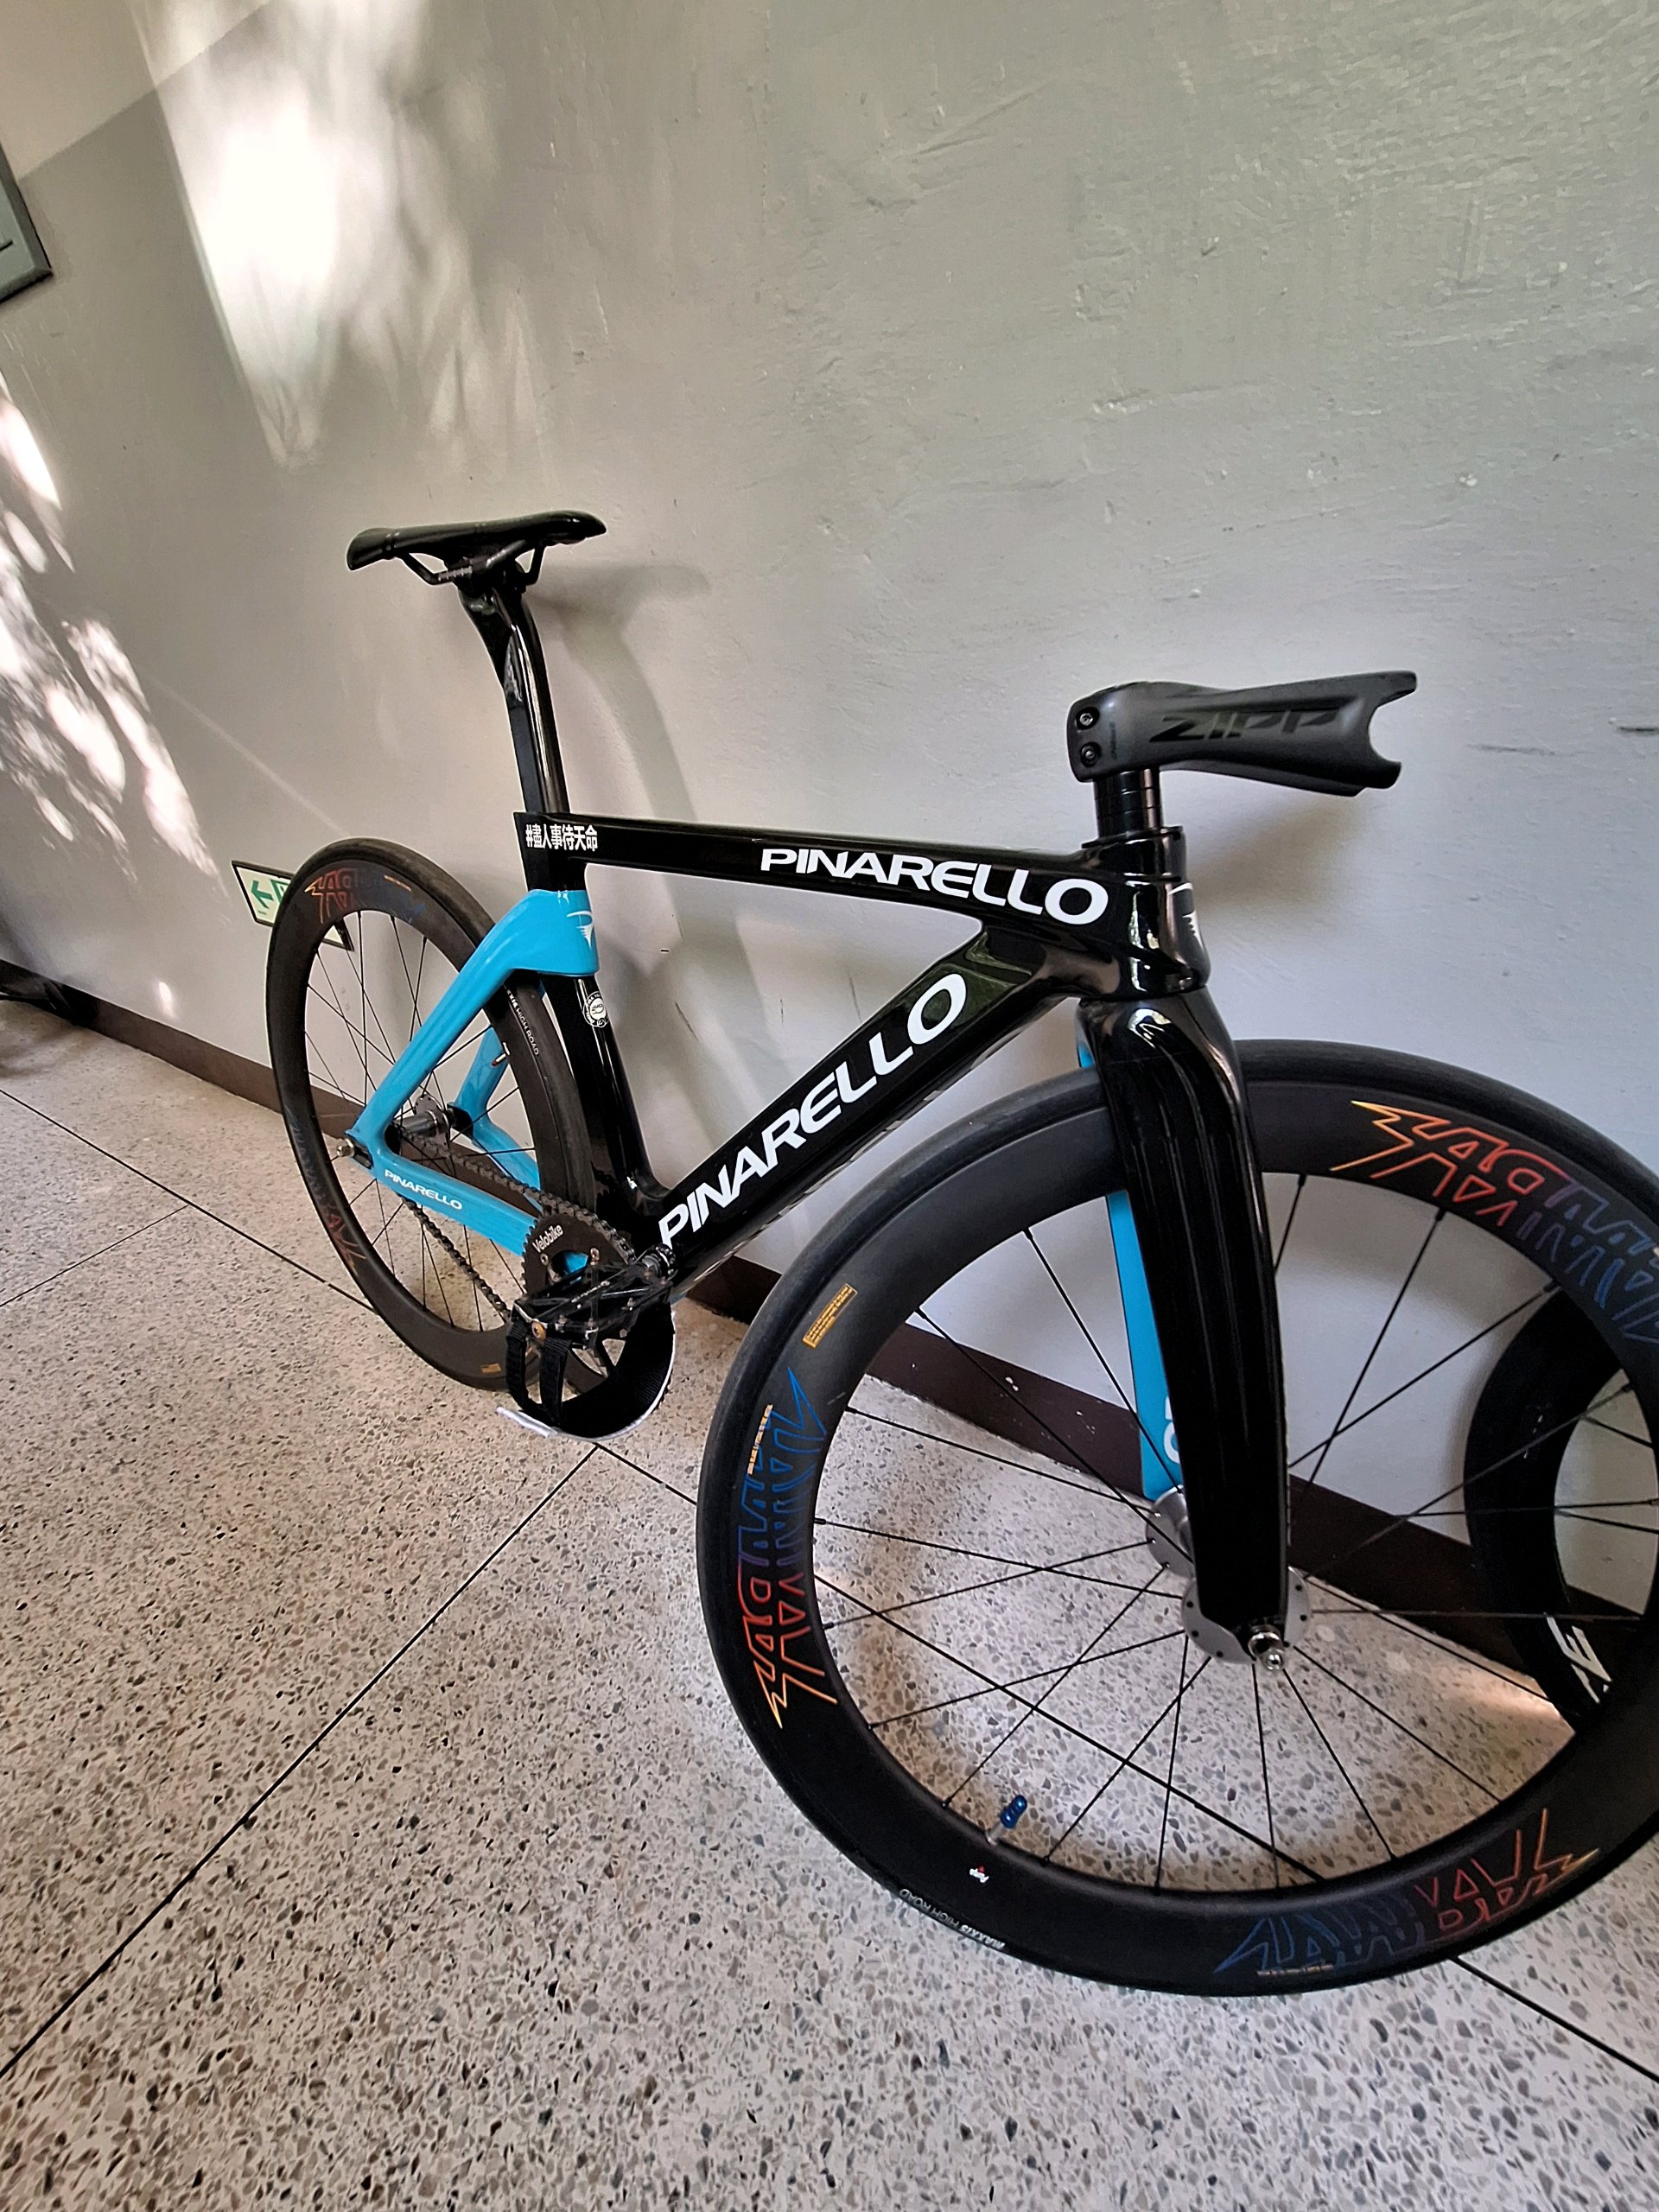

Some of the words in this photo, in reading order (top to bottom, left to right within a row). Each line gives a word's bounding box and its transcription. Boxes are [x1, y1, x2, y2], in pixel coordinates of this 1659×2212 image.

[1149, 710, 1339, 743] ZIPP
[760, 849, 1109, 925] PINARELLO
[516, 1007, 529, 1030] HIGH
[526, 1029, 539, 1055] ROAD
[658, 973, 967, 1249] PINARELLO
[385, 1168, 463, 1210] PINARELLO
[531, 1224, 563, 1253] Velobike
[899, 1888, 931, 1911] ROAD
[931, 1907, 960, 1928] HIGH
[959, 1924, 1006, 1950] MAXXIS
